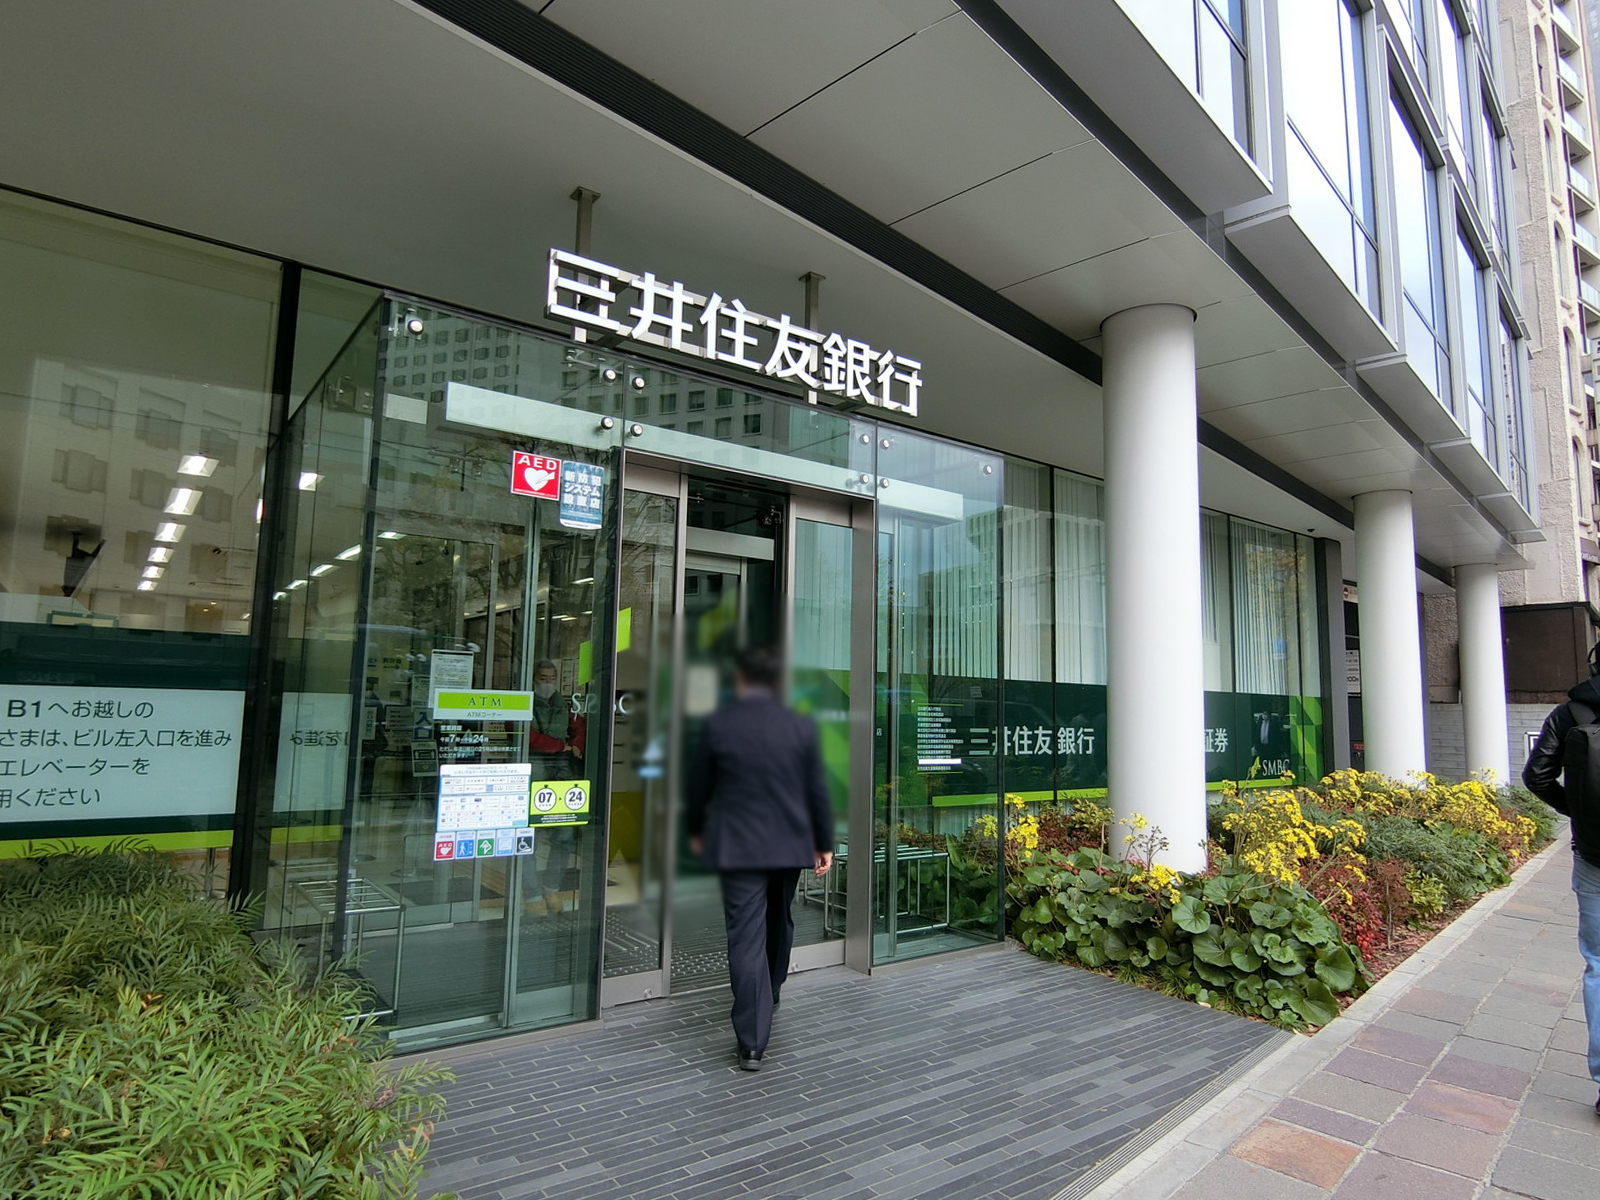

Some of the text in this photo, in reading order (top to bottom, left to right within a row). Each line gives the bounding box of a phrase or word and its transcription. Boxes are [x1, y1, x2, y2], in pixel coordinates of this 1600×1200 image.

[549, 248, 922, 417] 三井住友銀行
[518, 455, 557, 470] AED
[565, 482, 601, 497] システム
[7, 699, 154, 719] B1へお越しの
[468, 696, 502, 707] ATM
[0, 729, 232, 748] さまは、ビル左入口を進み
[969, 725, 1095, 756] 三井住友銀行
[0, 757, 150, 777] エレベーターを
[538, 792, 553, 803] 07
[568, 790, 583, 802] 24
